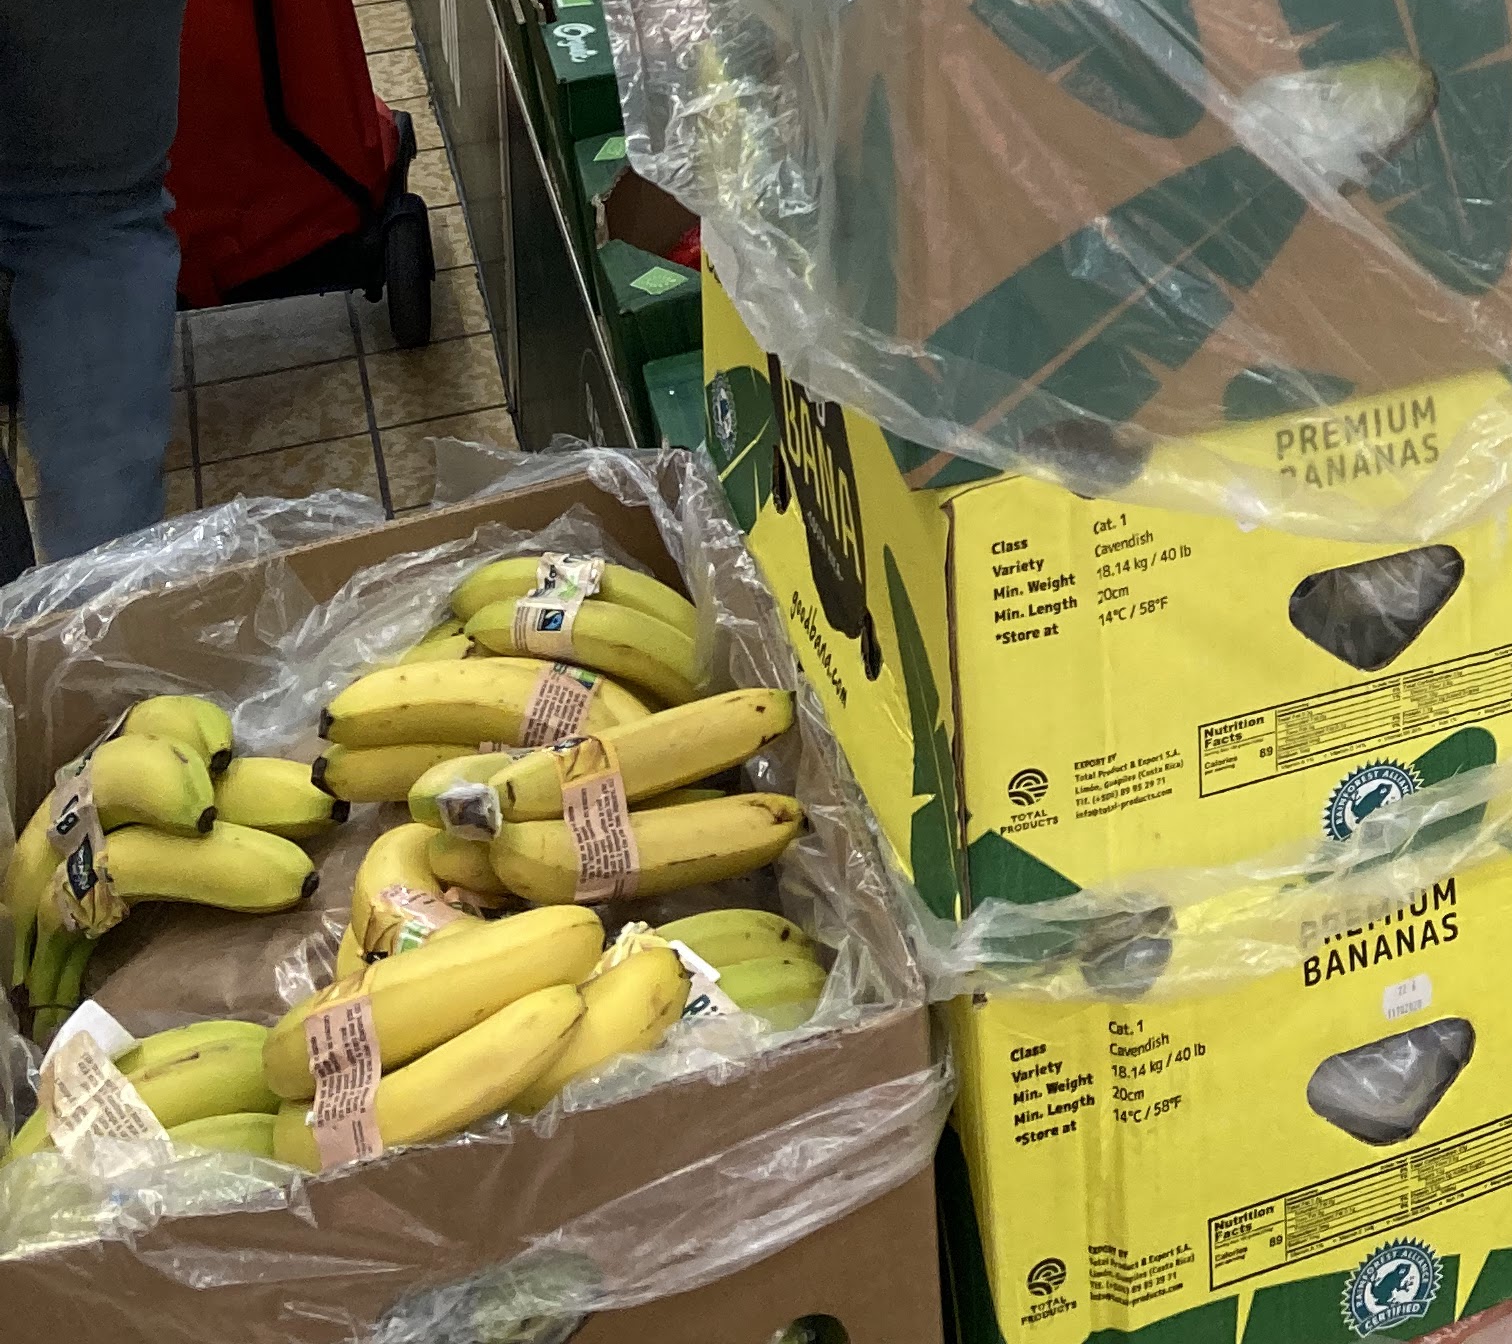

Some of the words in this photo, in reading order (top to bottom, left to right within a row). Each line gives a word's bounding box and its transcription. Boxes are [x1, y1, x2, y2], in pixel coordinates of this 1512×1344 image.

[1275, 395, 1437, 461] PREMIUM
[991, 537, 1029, 556] Class
[992, 556, 1045, 579] Variety
[1094, 530, 1155, 559] Cavendish
[993, 585, 1025, 602] Min.
[1027, 573, 1076, 595] Weight
[994, 607, 1026, 624] Min.
[1028, 596, 1078, 619] Length
[790, 590, 848, 709] goodbana.com
[1203, 714, 1266, 739] Nutrition
[1204, 731, 1244, 750] Facts
[1000, 815, 1060, 836] PRODUCTS
[1010, 809, 1049, 824] TOTAL
[1302, 911, 1460, 989] BANANAS
